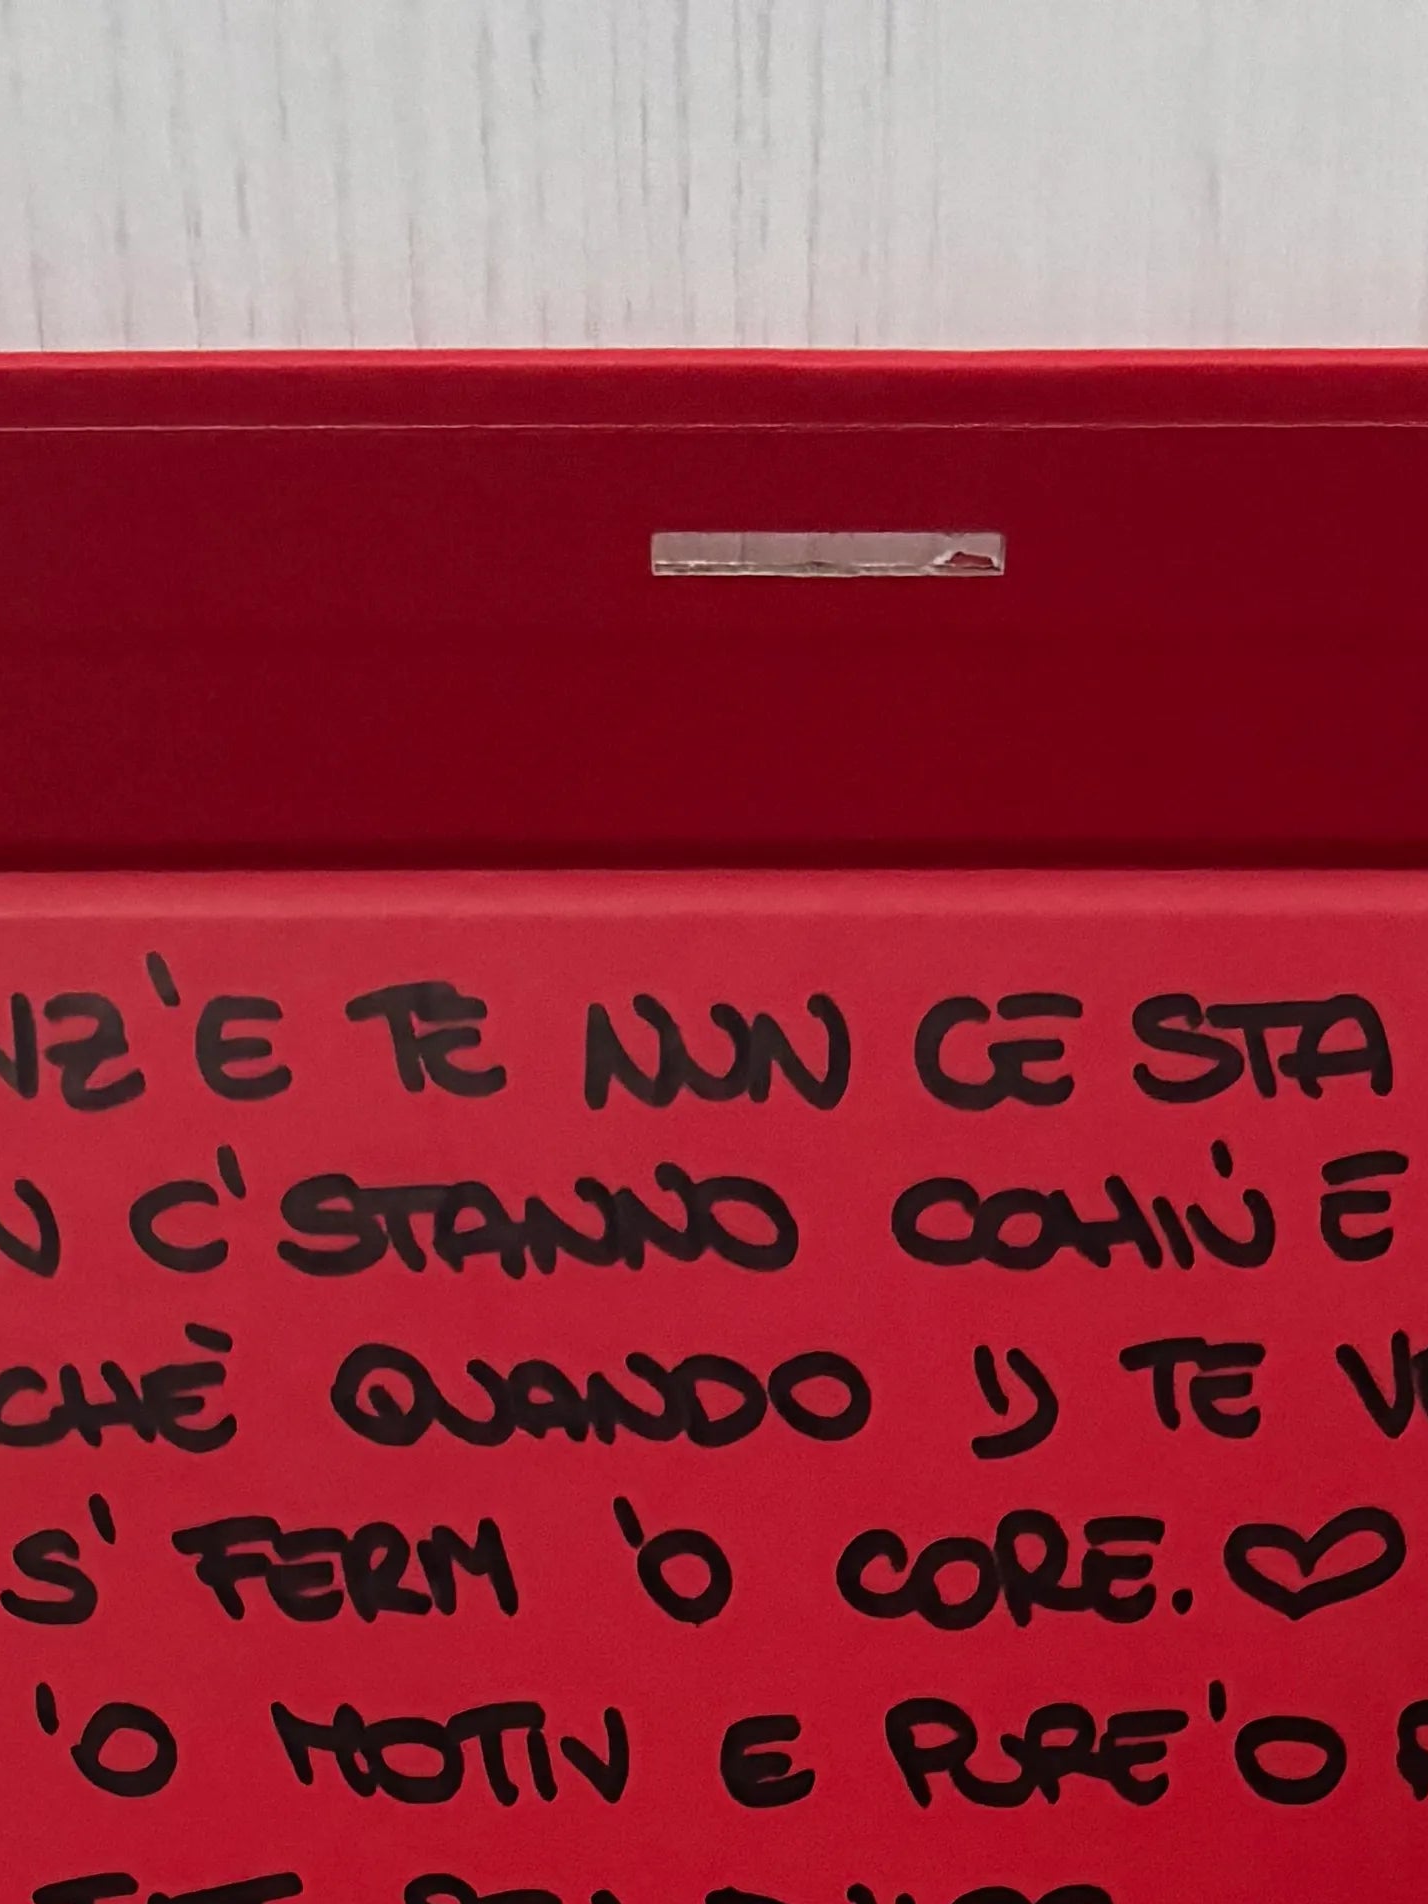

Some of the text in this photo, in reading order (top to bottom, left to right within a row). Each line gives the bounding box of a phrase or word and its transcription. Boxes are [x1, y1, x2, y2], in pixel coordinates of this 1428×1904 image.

[346, 983, 506, 1096] TE
[585, 994, 850, 1109] NUN
[915, 993, 1082, 1110] CE
[1132, 994, 1392, 1103] STA
[1321, 1151, 1408, 1261] E
[331, 1344, 870, 1447] QUANDO
[1119, 1337, 1265, 1438] TE
[172, 1516, 518, 1622] FERM
[271, 1702, 629, 1806] MOTIV
[720, 1715, 815, 1808] E
